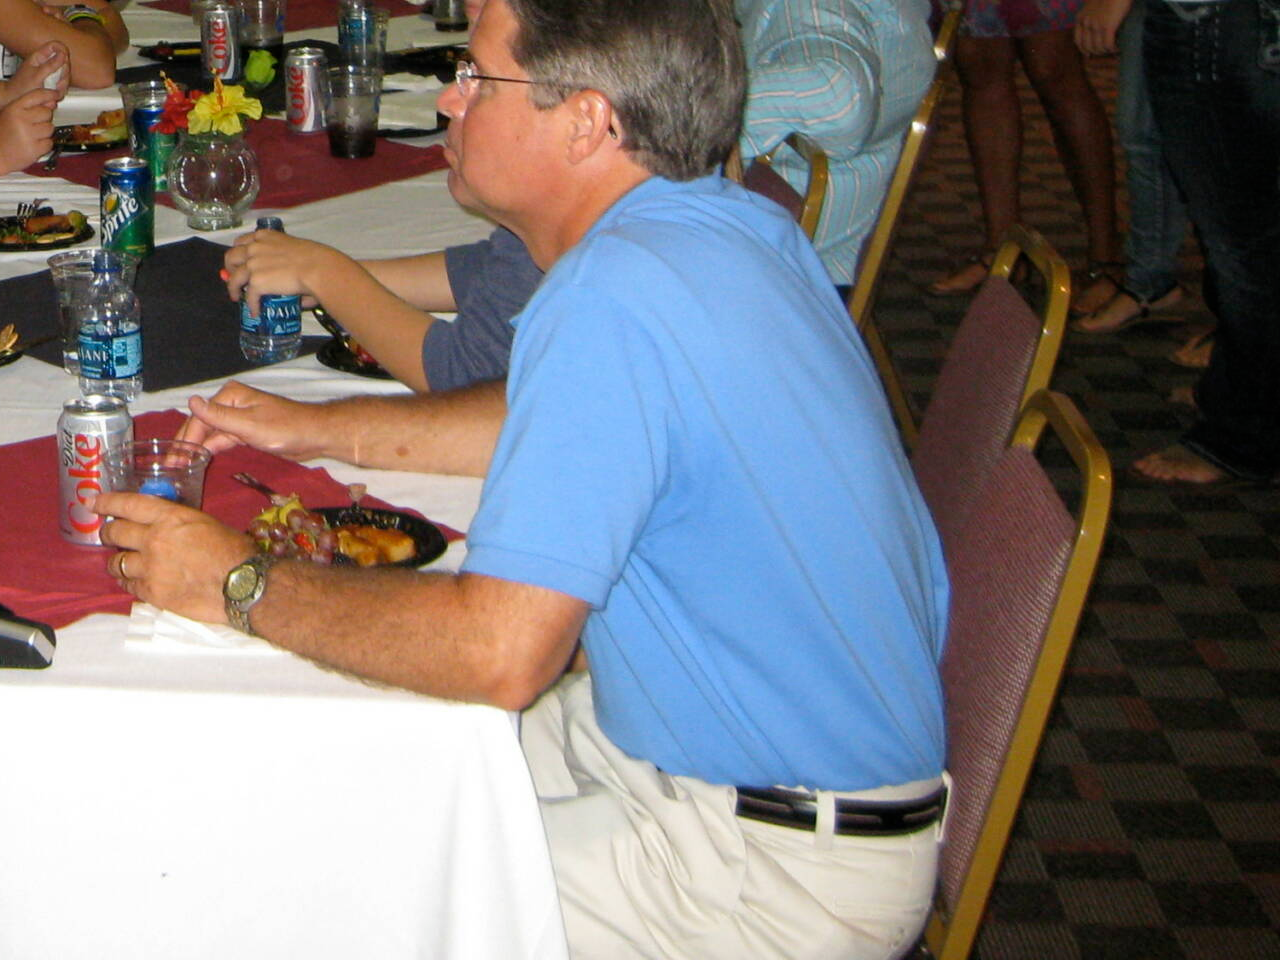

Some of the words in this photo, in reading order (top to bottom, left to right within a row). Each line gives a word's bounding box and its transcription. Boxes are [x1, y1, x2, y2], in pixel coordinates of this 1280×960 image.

[288, 65, 306, 126] Coke
[63, 429, 74, 468] Diet
[68, 433, 104, 534] Coke
